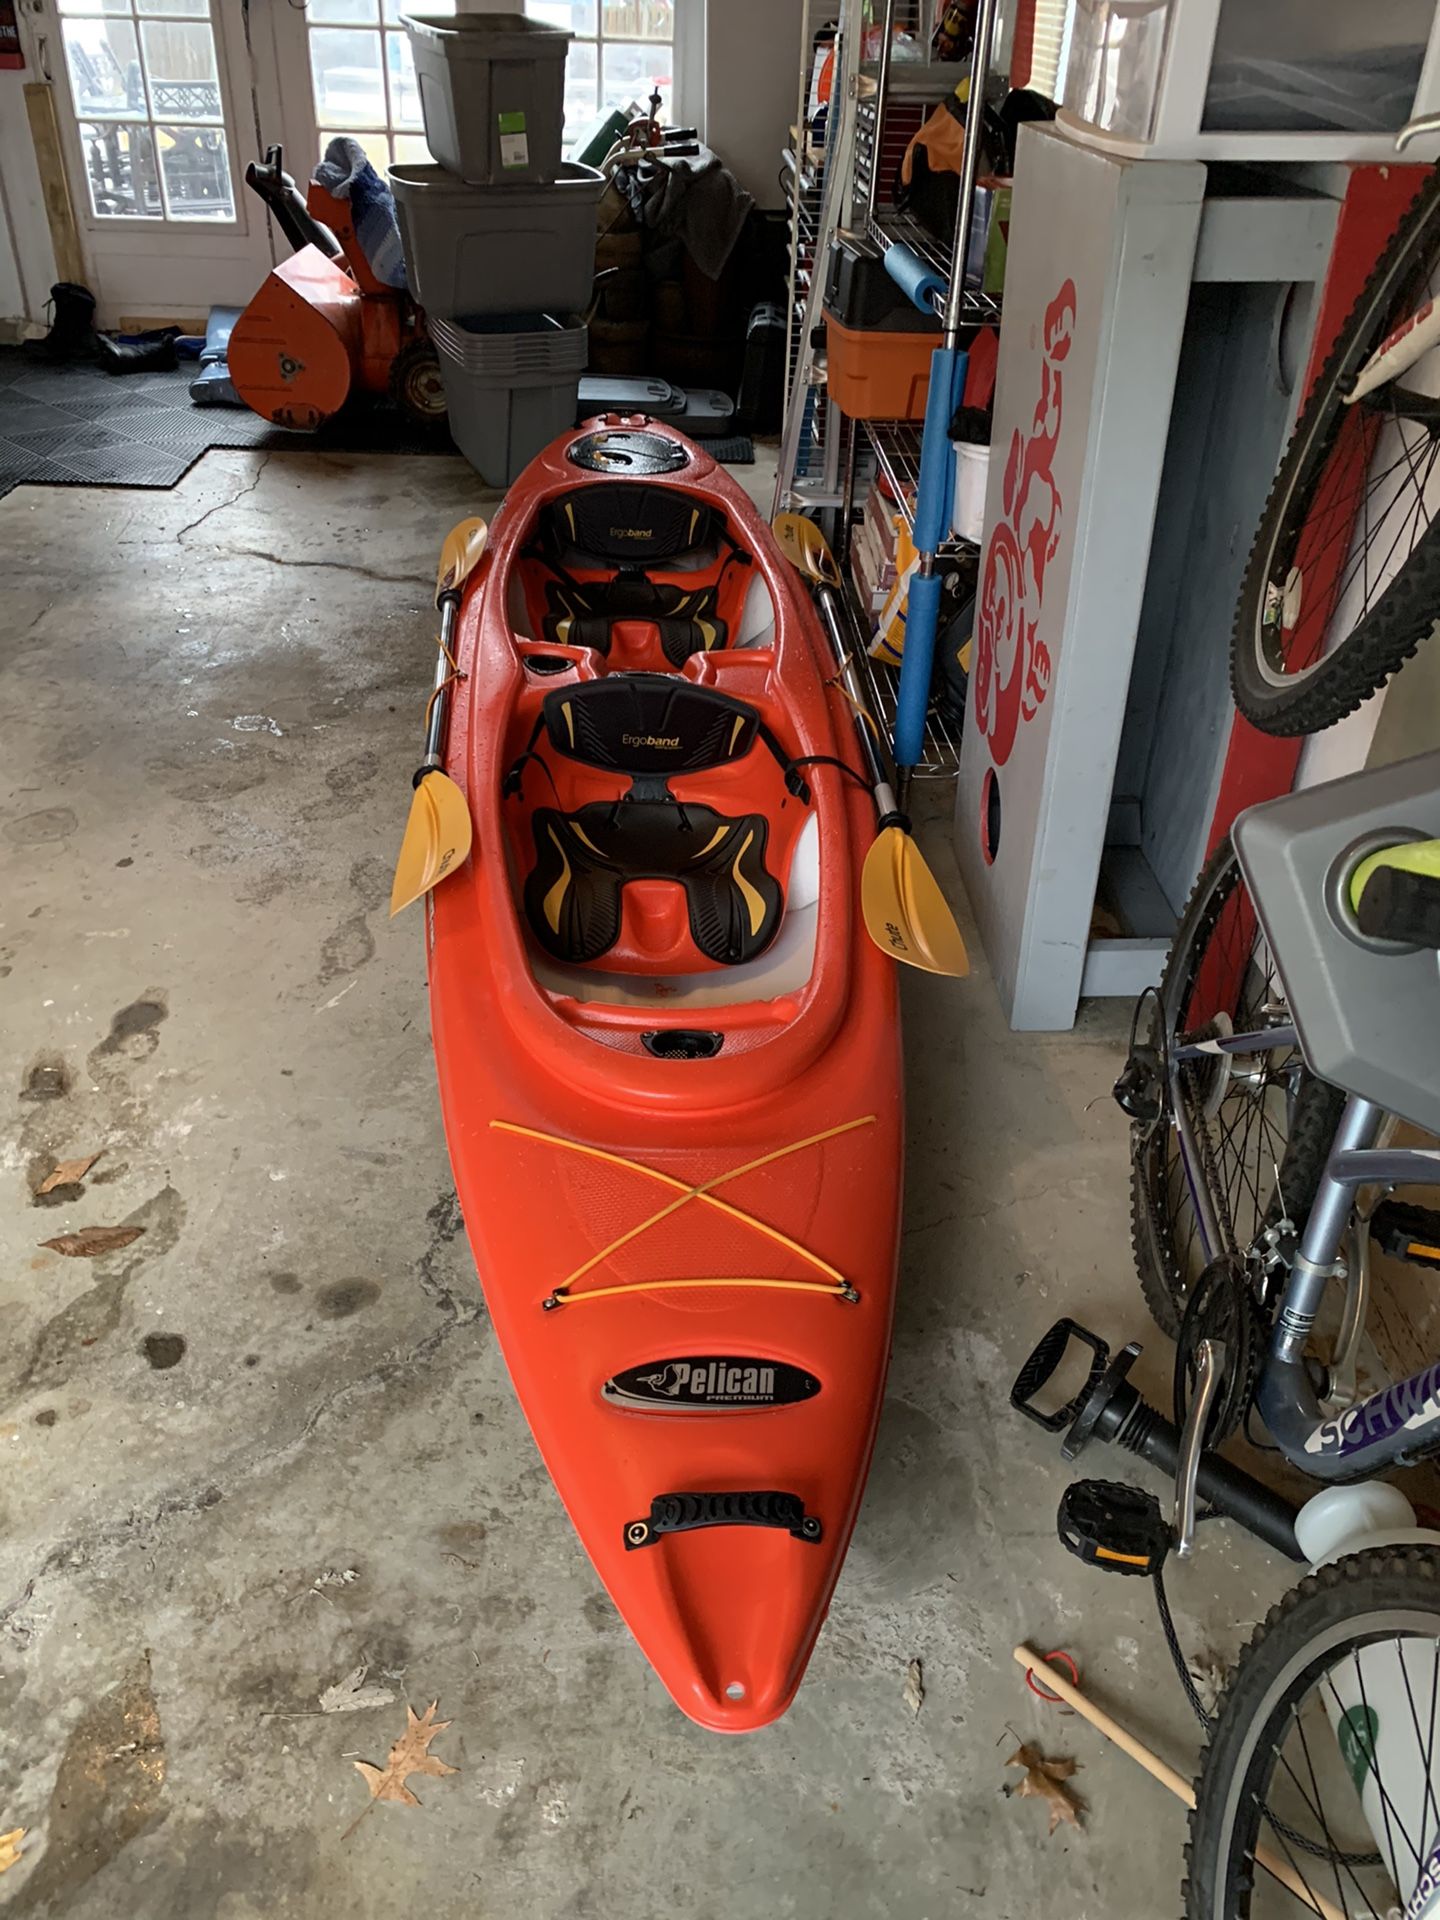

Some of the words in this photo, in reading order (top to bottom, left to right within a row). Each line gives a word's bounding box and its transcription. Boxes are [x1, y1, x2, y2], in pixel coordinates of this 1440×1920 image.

[609, 527, 652, 539] Ergoband
[622, 733, 680, 748] Ergoband
[885, 922, 908, 951] Chute
[674, 1362, 775, 1395] Pelican
